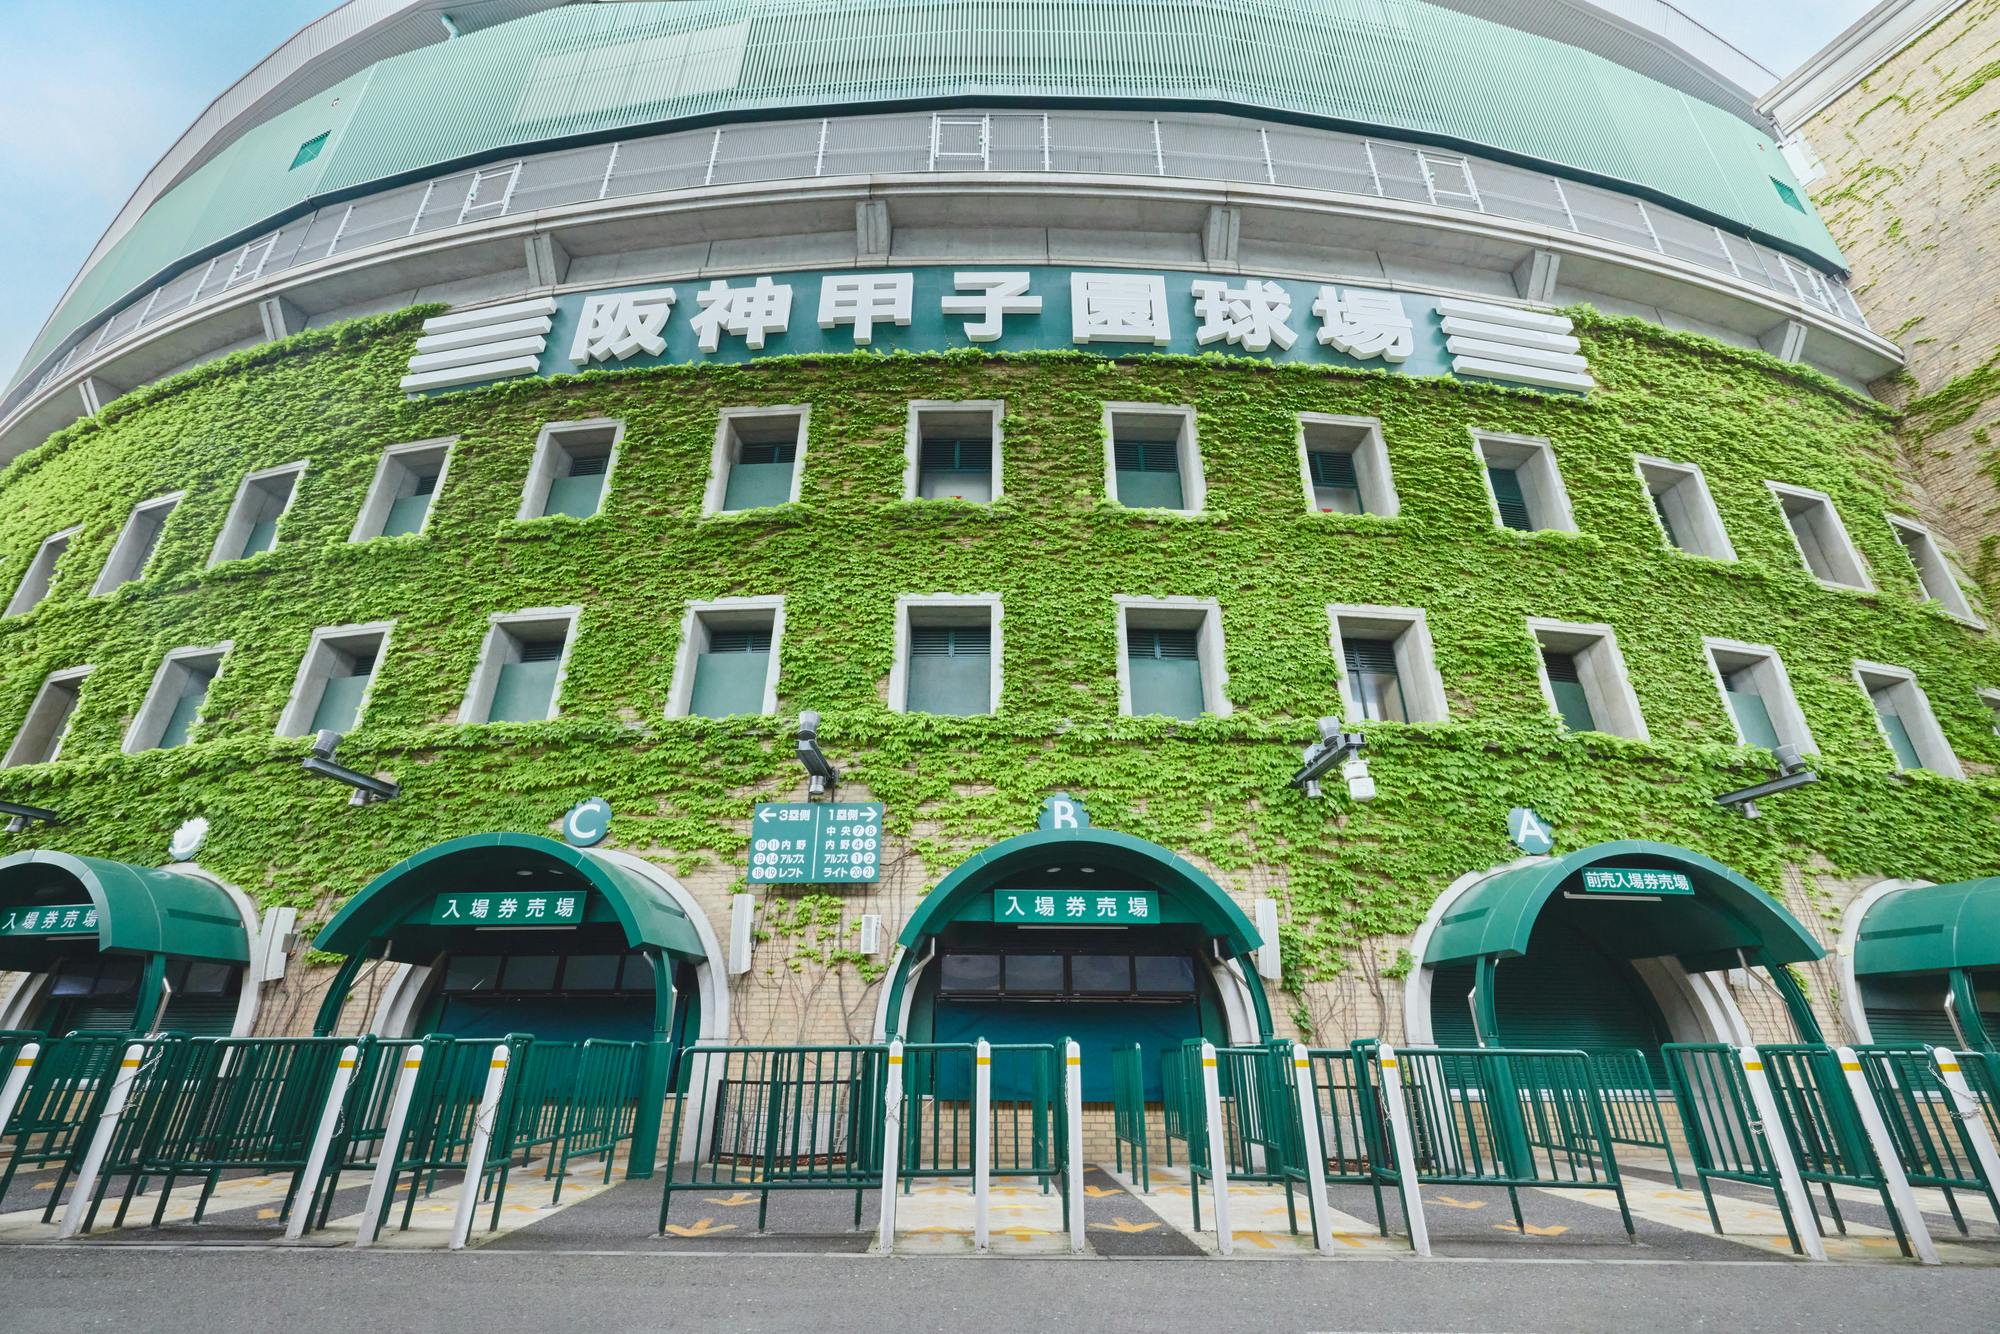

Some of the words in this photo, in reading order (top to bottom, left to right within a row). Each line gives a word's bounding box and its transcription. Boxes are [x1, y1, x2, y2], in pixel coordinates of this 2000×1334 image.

[568, 271, 1412, 366] 阪神甲子園球場
[569, 803, 601, 838] C
[779, 809, 810, 821] 3塁側
[828, 809, 859, 821] 1塁側
[826, 826, 851, 836] 中央
[1518, 809, 1550, 844] A
[781, 839, 807, 850] 内野
[825, 839, 850, 850] 内野
[780, 853, 805, 864] アルプス
[824, 853, 849, 864] アルプス
[779, 867, 803, 878] レフト
[823, 867, 848, 878] ライト
[1585, 872, 1690, 891] 前売入場券売場
[442, 897, 575, 918] 入場券売場
[1005, 896, 1149, 917] 入場券売場
